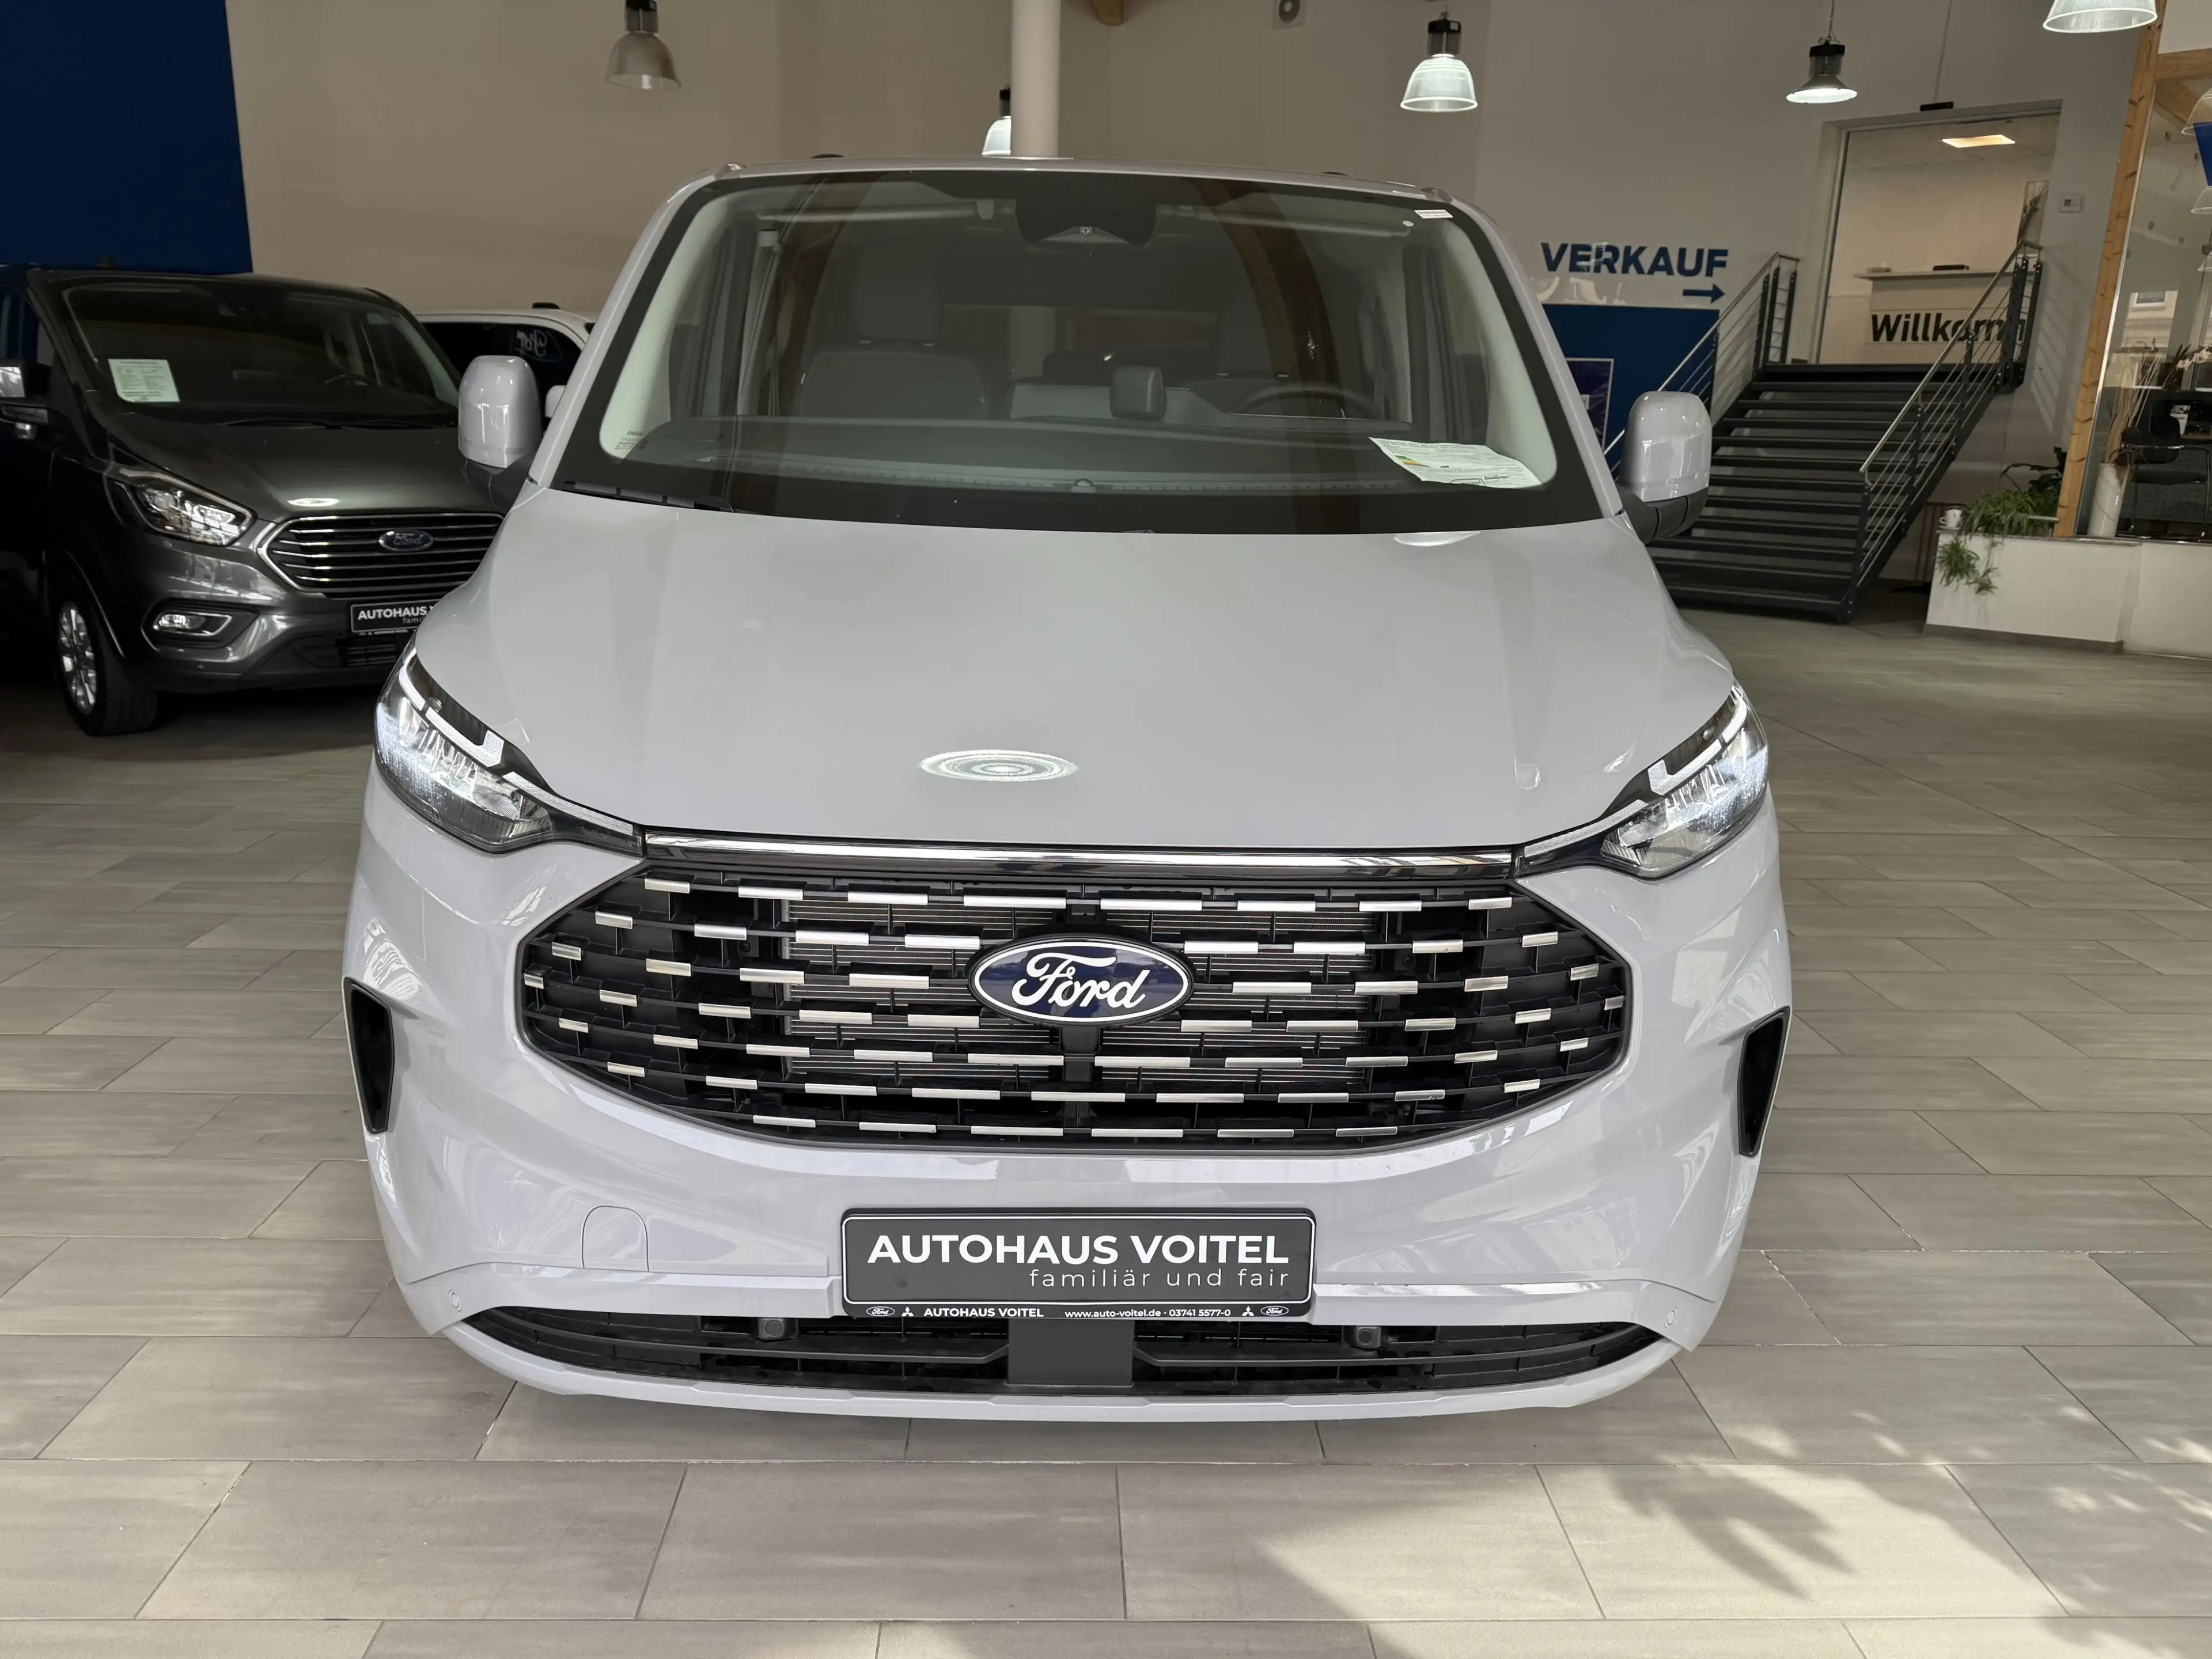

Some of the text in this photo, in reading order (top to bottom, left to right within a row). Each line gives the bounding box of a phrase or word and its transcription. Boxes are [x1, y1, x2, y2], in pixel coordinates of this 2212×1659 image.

[1540, 242, 1729, 277] VERKAUF
[357, 605, 427, 620] AUTOHAUS
[1012, 952, 1150, 1009] Ford
[867, 1234, 1289, 1265] AUTOHAUS VOITEL
[1029, 1268, 1289, 1287] familiär und fair
[923, 1308, 1044, 1317] AUTOHAUS VOITEL
[1064, 1309, 1231, 1317] www.auto-voitel.de 03741 5577-0
